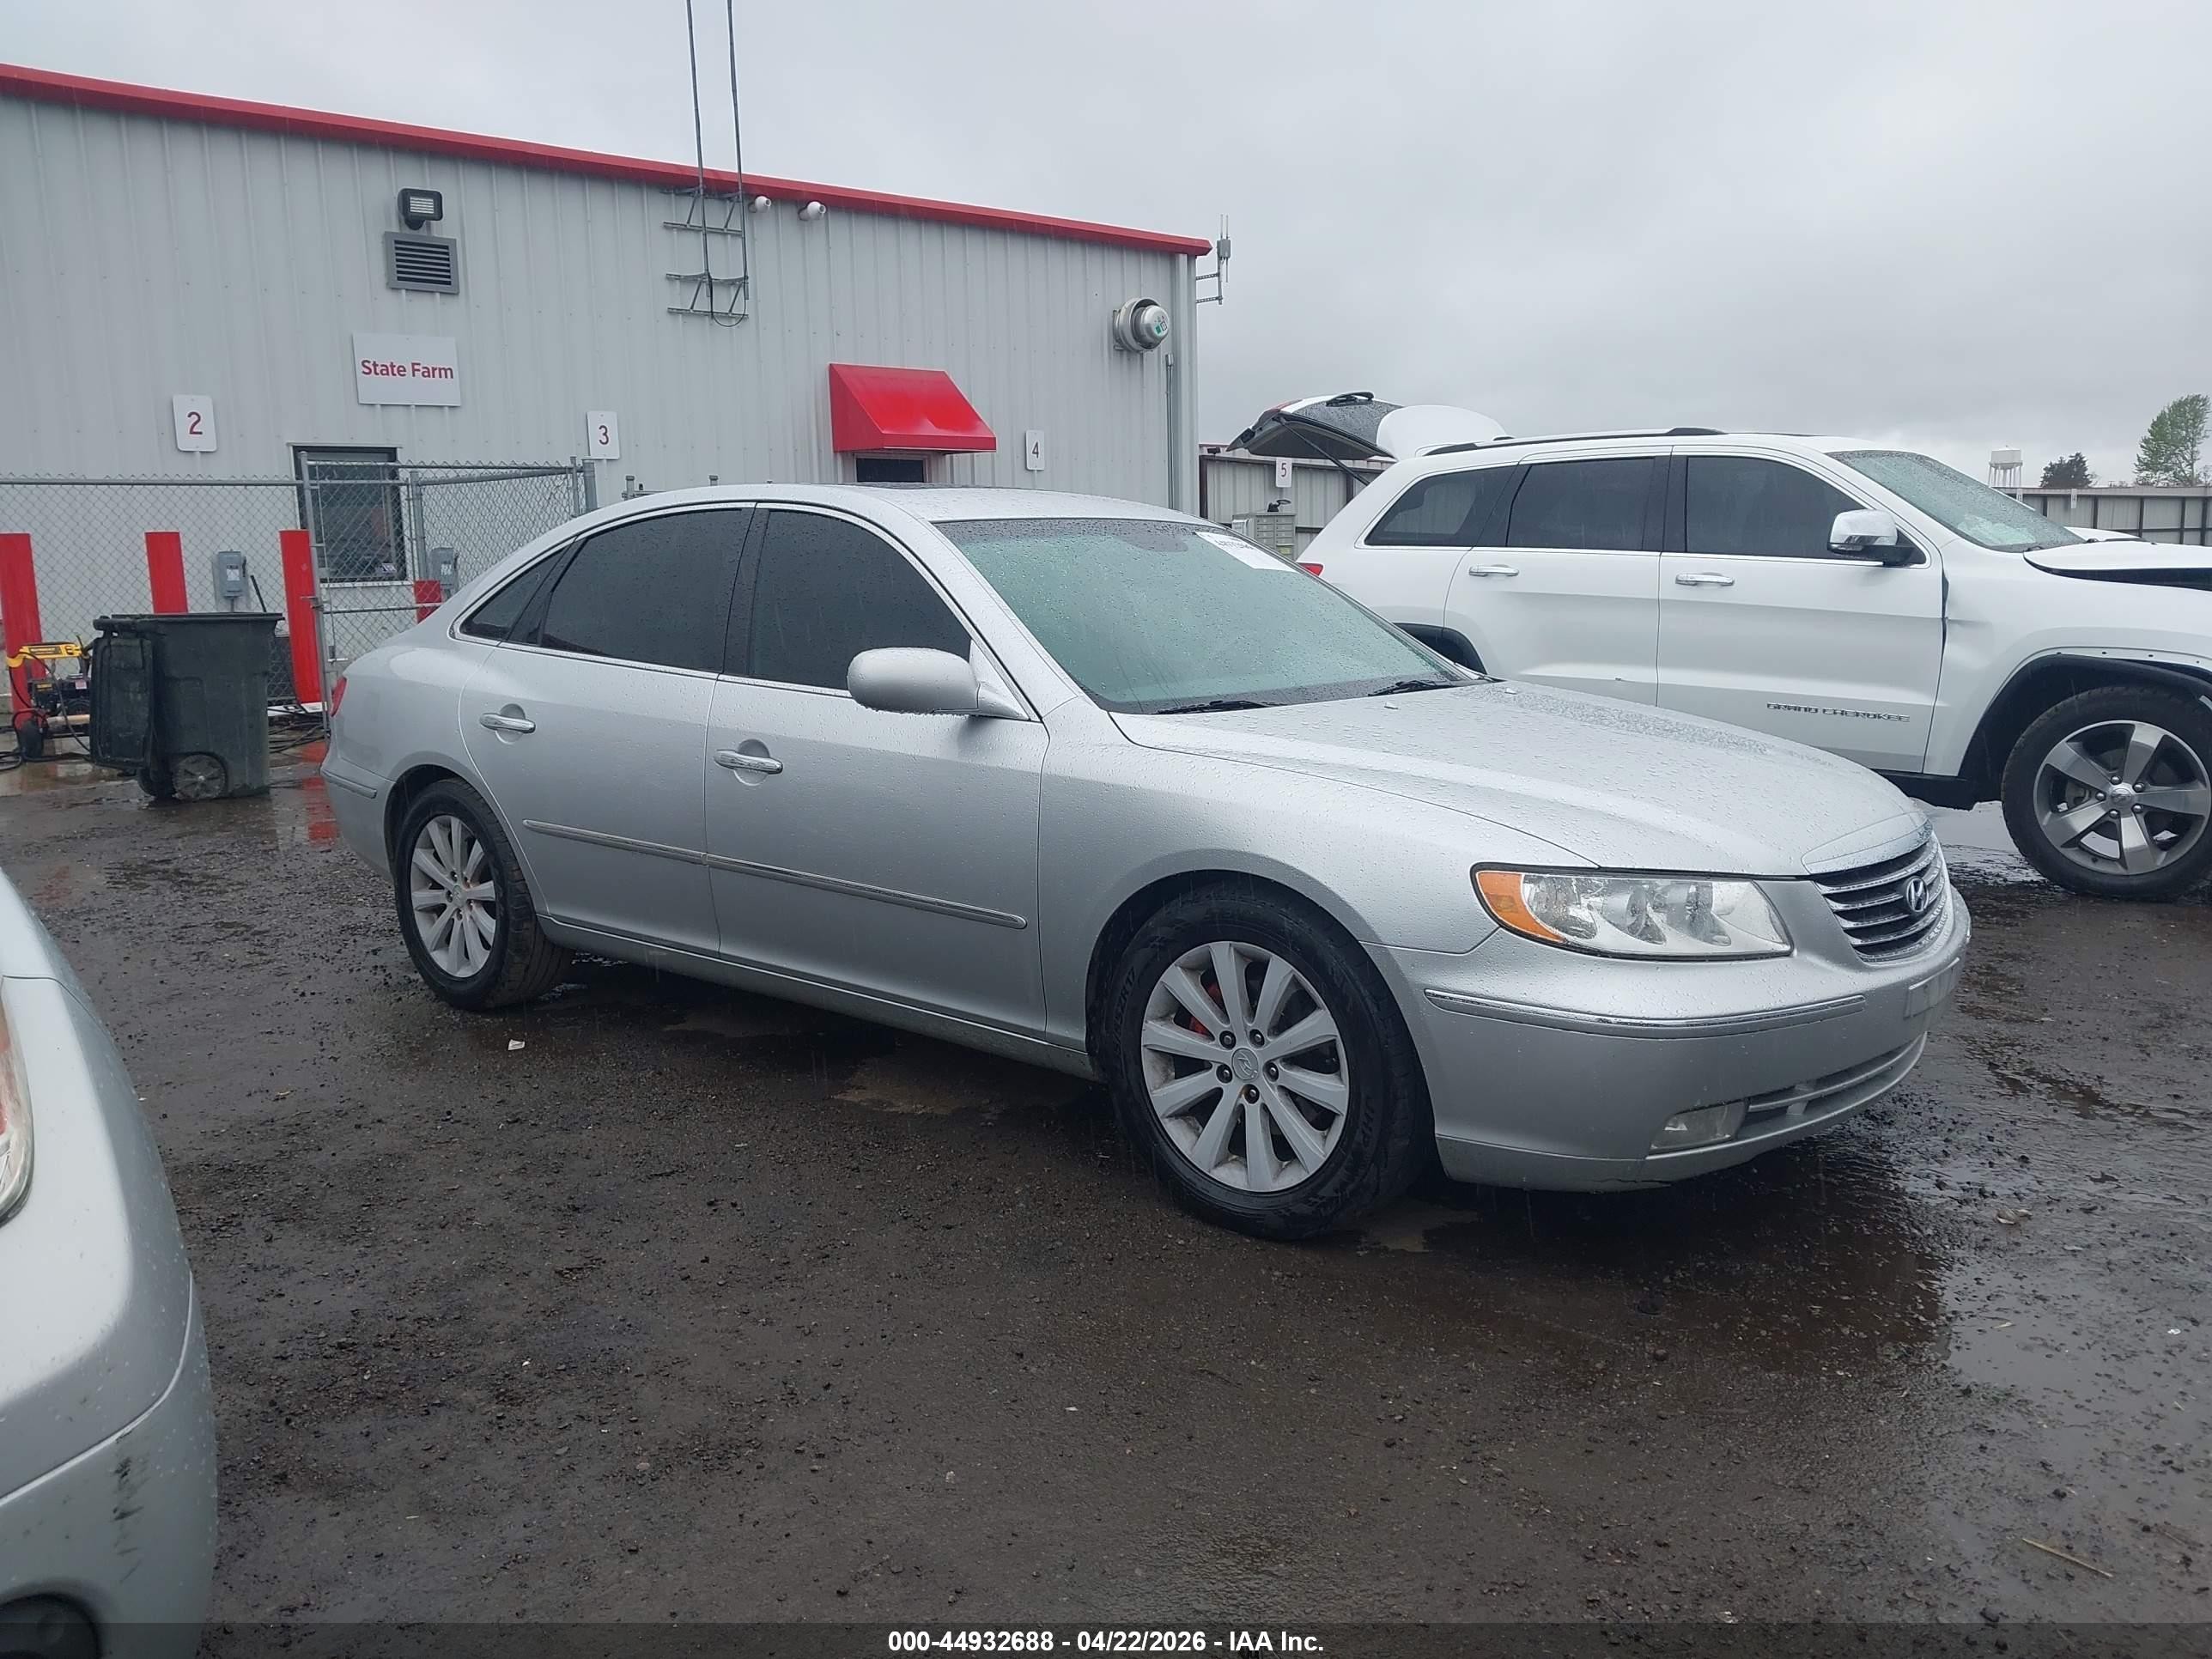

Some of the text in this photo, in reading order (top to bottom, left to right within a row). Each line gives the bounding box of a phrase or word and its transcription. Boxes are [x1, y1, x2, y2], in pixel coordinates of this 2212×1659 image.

[361, 360, 454, 379] State Farm
[187, 411, 203, 435] 2
[599, 424, 609, 446] 3
[1031, 441, 1039, 459] 4
[1280, 462, 1287, 477] 5
[1766, 702, 1911, 722] GRAND CHEROKEE
